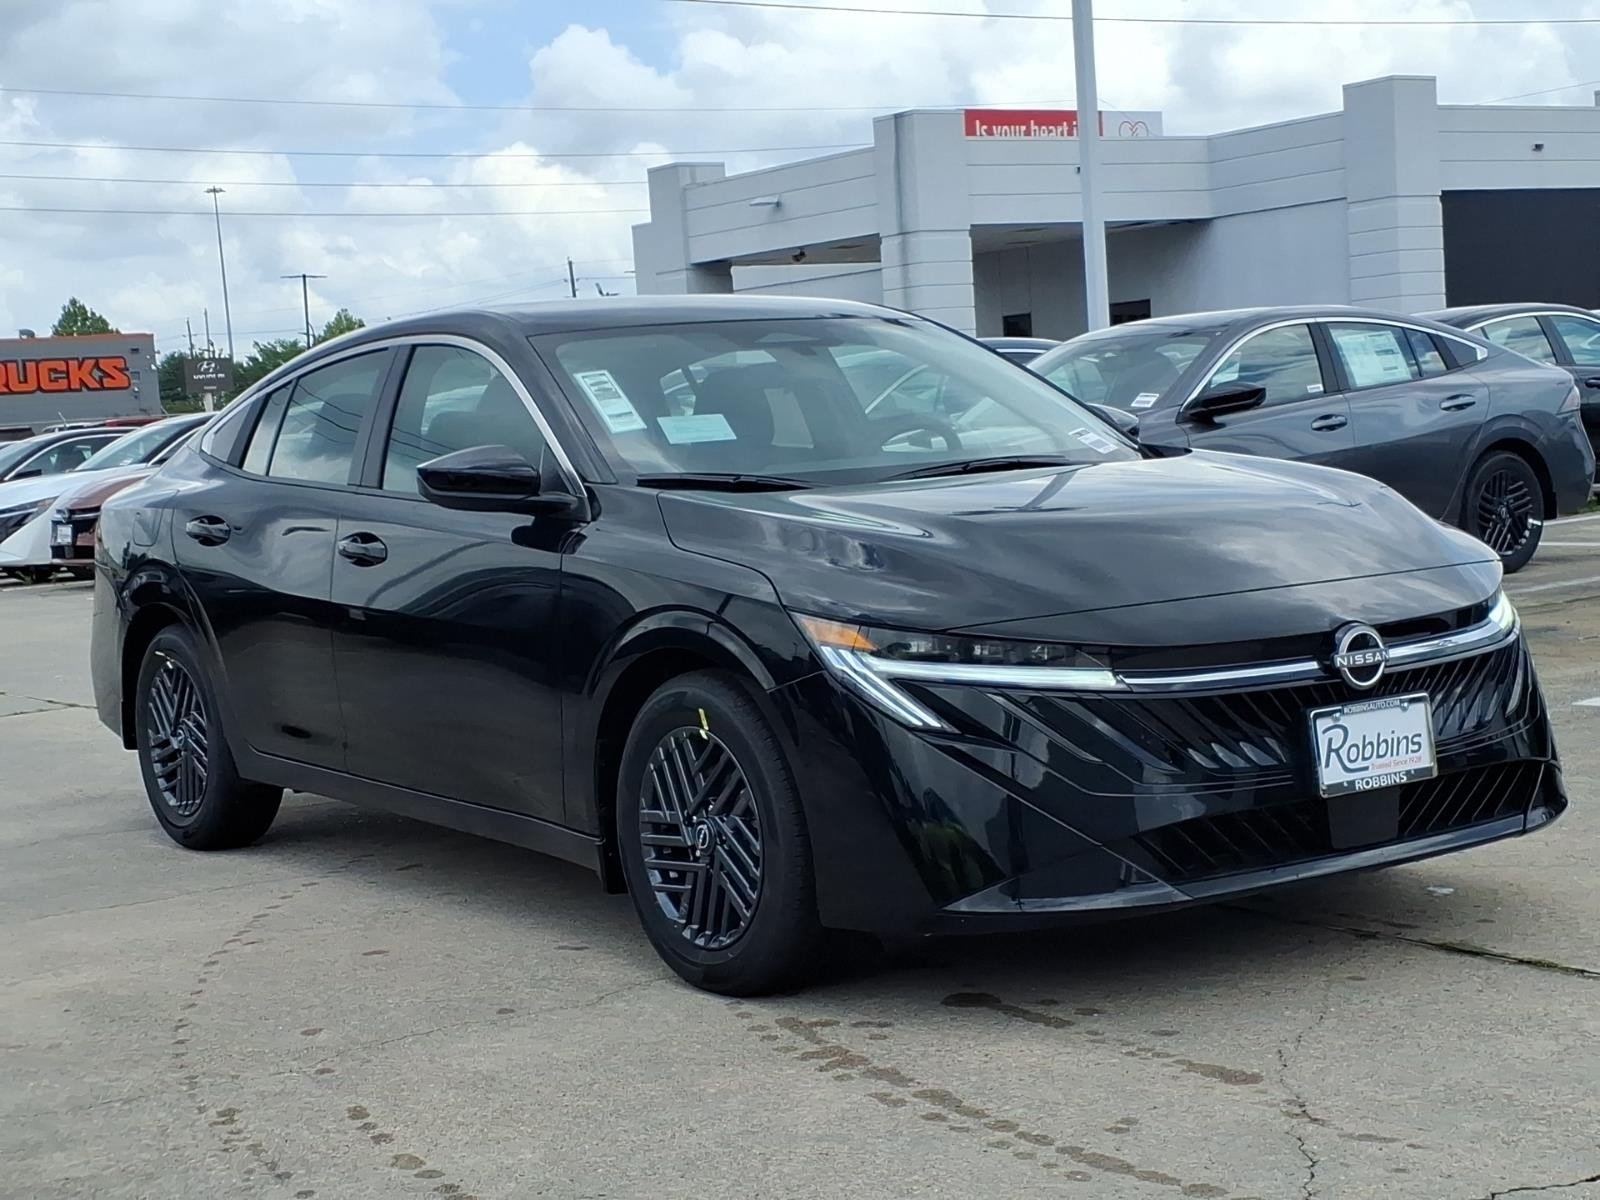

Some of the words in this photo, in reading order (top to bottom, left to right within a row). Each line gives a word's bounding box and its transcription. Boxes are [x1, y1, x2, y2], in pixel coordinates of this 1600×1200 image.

[992, 124, 1027, 137] your
[1030, 119, 1069, 137] heart
[1336, 650, 1390, 668] NISSAN
[1322, 723, 1422, 774] Robbins
[1355, 770, 1408, 791] ROBBINS
